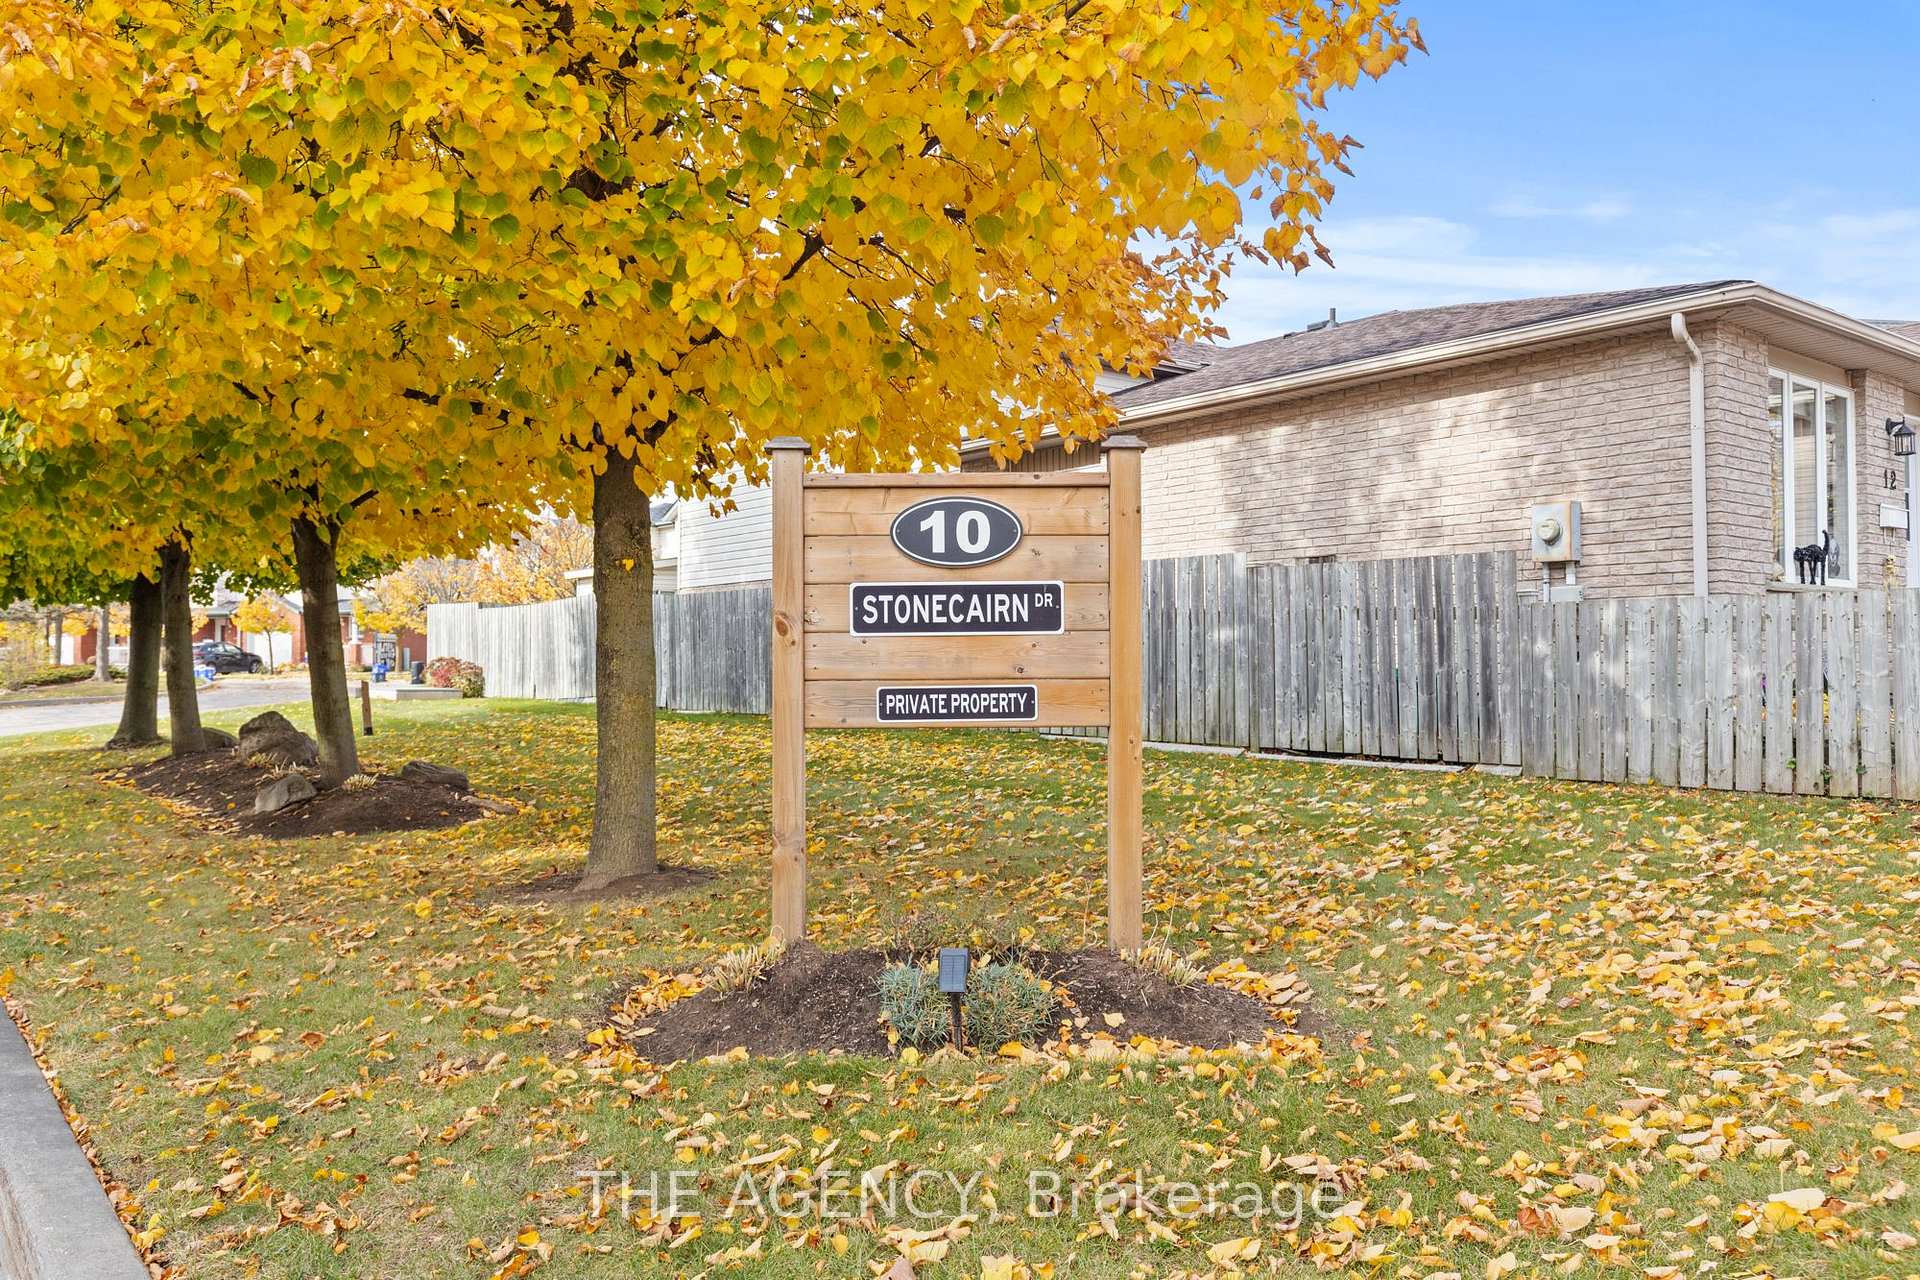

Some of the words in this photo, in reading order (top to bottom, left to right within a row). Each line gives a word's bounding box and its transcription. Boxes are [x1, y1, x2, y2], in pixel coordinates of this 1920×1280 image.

[1884, 469, 1897, 490] 12
[919, 510, 991, 554] 10
[862, 593, 1029, 624] STONECAIRN
[1035, 593, 1053, 608] DR
[886, 694, 948, 715] PRIVATE
[951, 693, 1028, 713] PROPERTY
